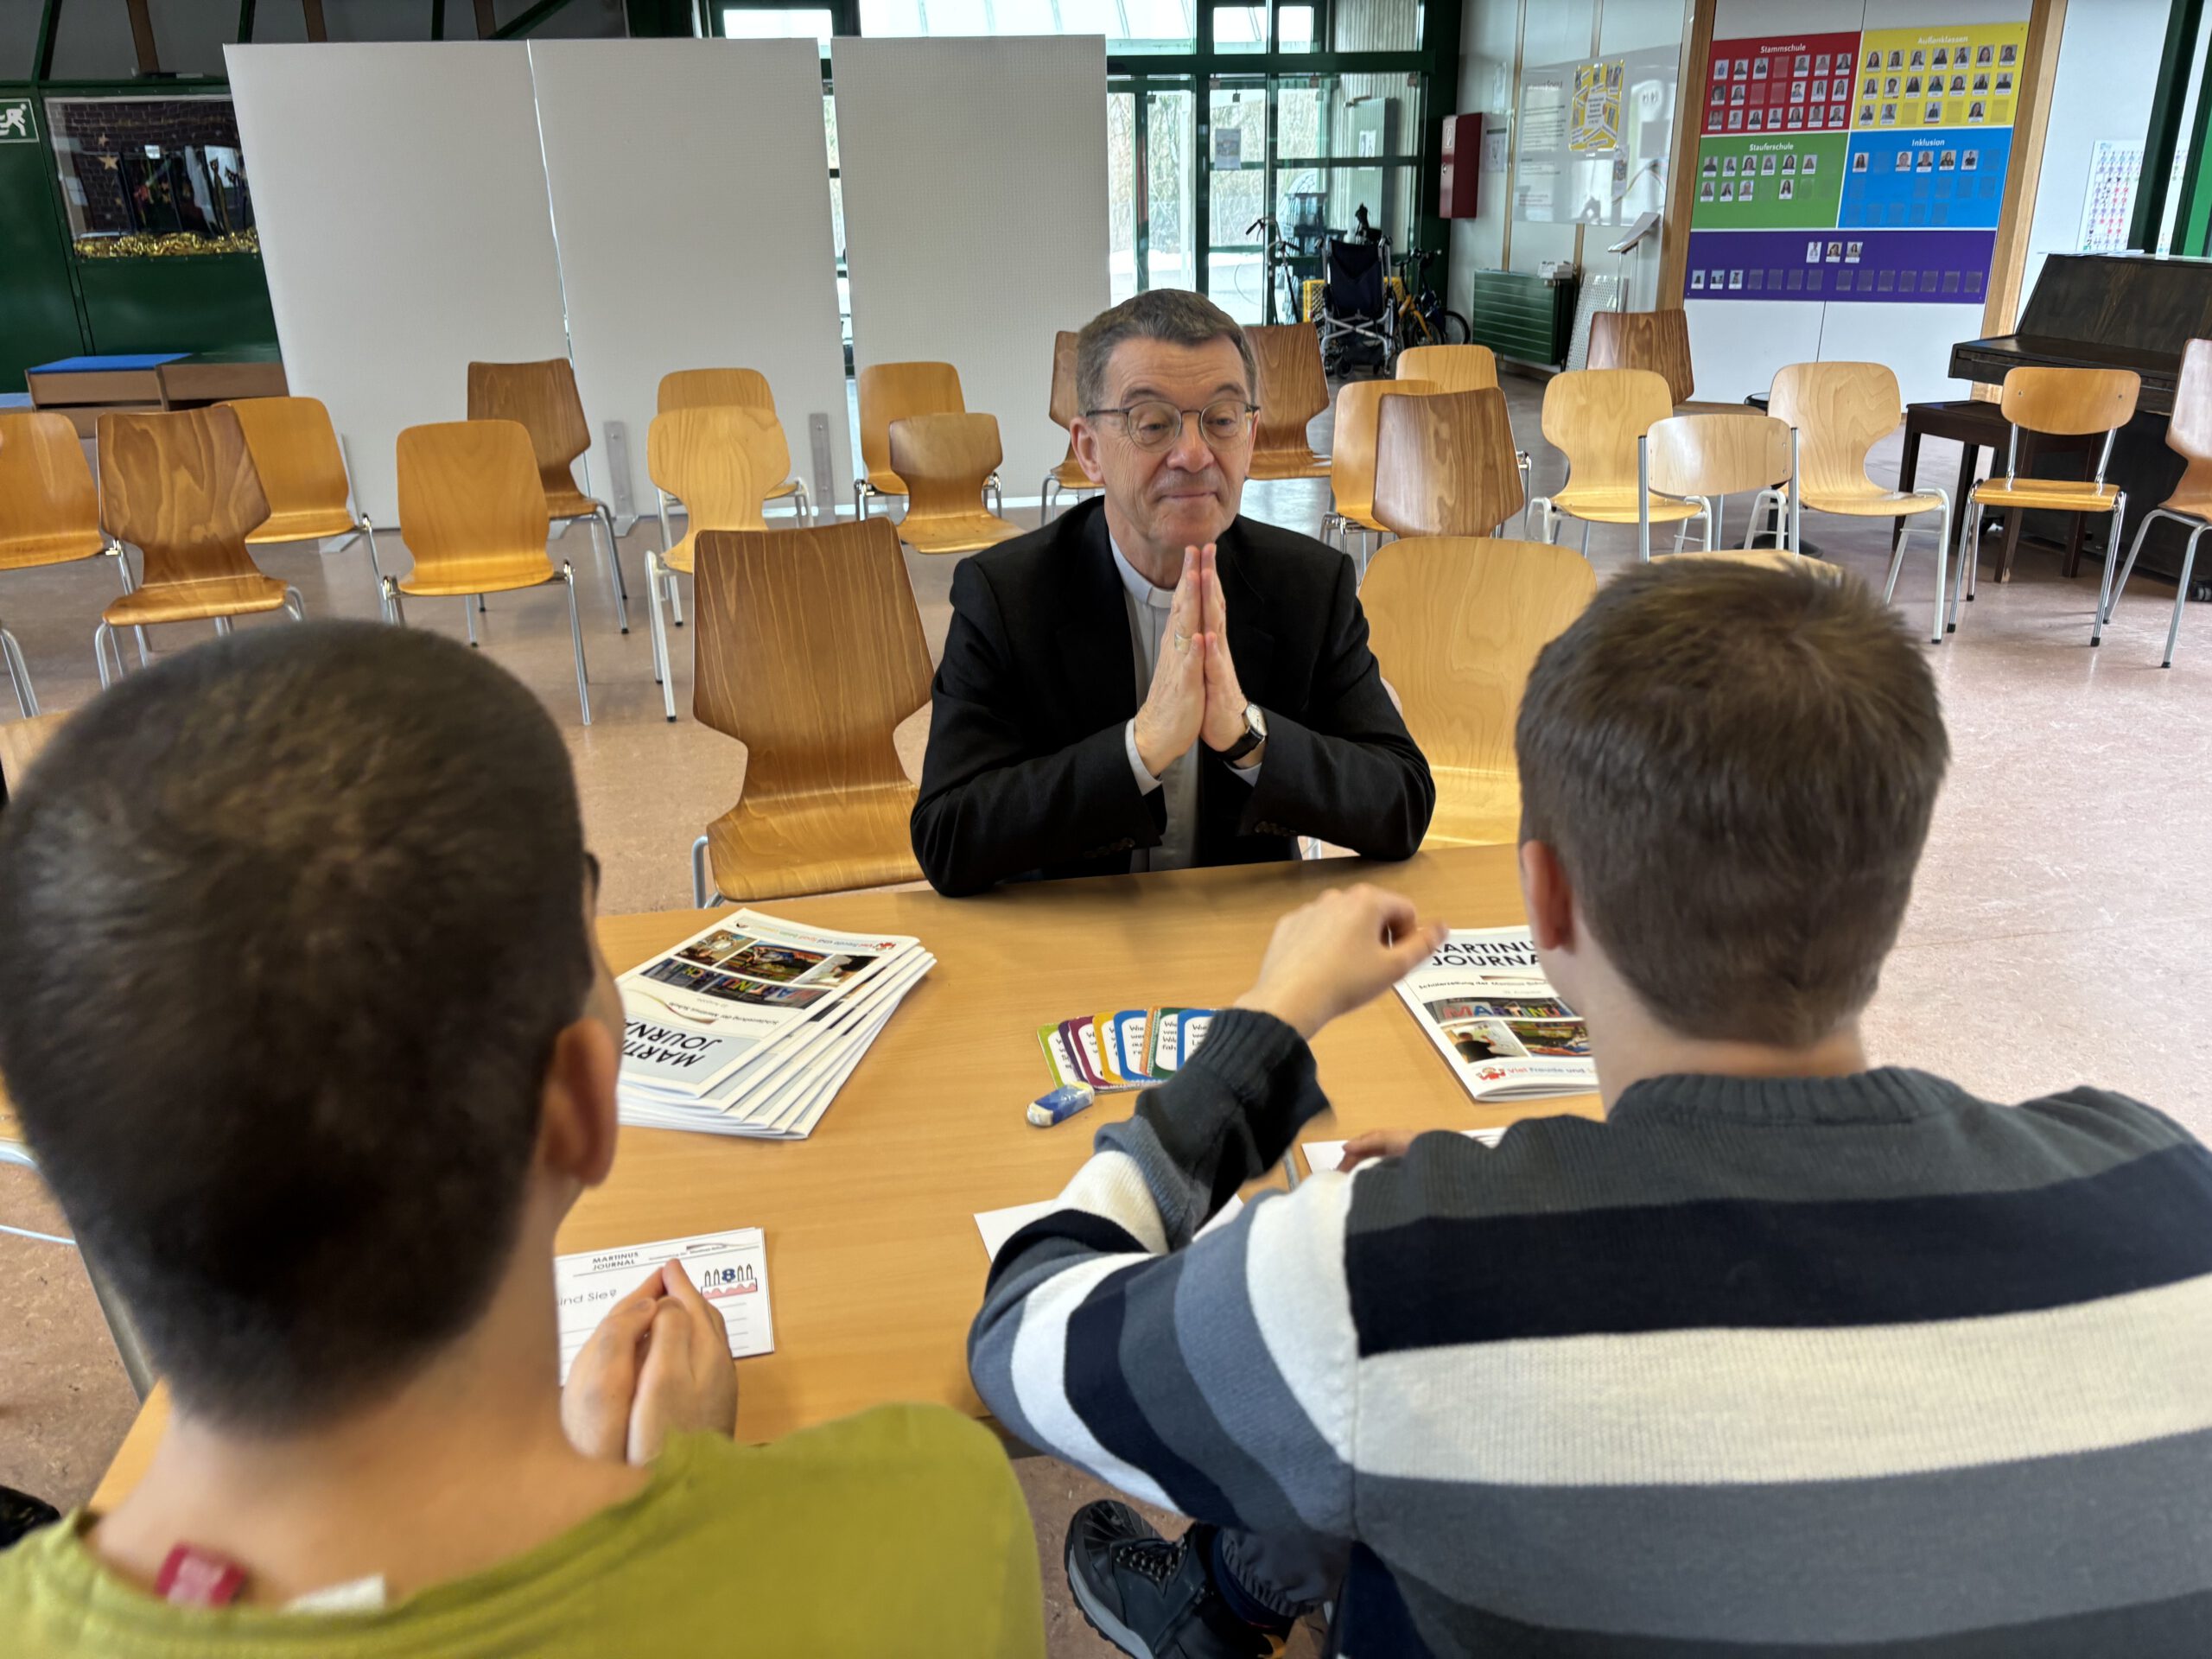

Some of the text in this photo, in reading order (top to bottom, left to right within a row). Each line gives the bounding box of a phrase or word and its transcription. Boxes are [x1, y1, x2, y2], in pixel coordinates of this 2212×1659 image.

[1760, 43, 1807, 53] Stammschule
[1749, 143, 1794, 151] Stauferschule
[1911, 138, 1944, 147] Inklusion
[1434, 941, 1535, 954] ARTINU
[1432, 955, 1540, 966] JOURNA
[624, 1018, 722, 1052] JOURNA
[622, 1039, 706, 1068] MARTI
[592, 1251, 639, 1264] MARTINUS
[593, 1259, 636, 1271] JOURNAL
